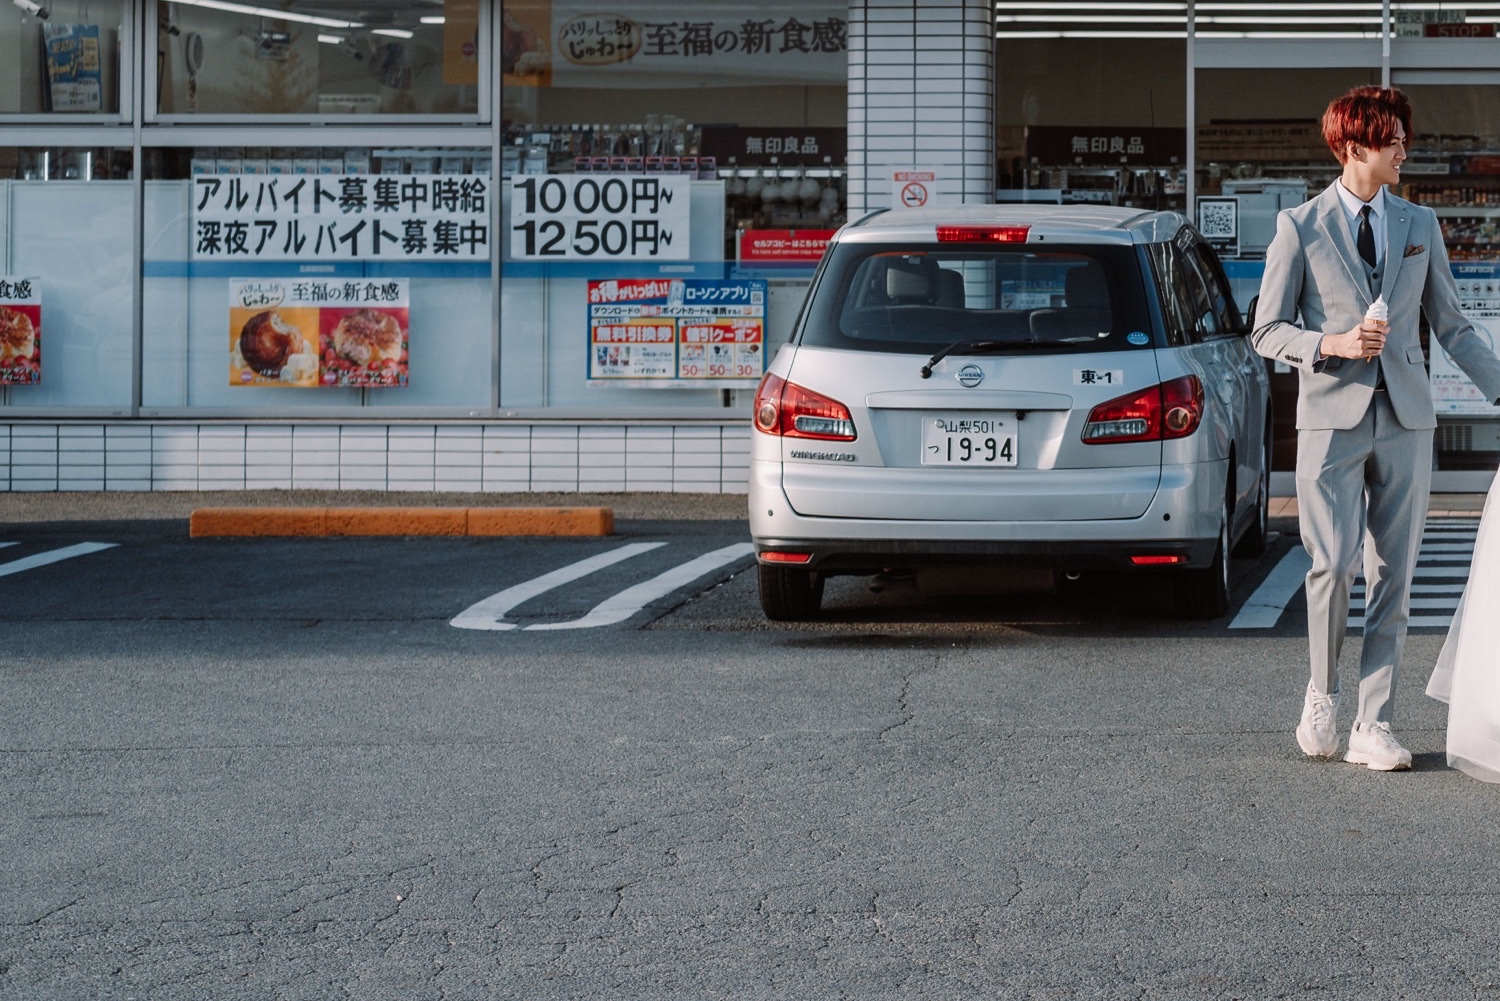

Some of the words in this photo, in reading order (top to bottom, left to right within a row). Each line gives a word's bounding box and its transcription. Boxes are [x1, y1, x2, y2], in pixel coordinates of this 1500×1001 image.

[644, 17, 847, 56] 至福の新食感
[746, 136, 819, 154] 無印良品
[1072, 136, 1144, 154] 無印良品
[196, 177, 487, 214] アルバイト募集中時給
[196, 219, 487, 256] 深夜アルバイト募集中
[291, 282, 400, 302] 至福の新食感
[686, 286, 748, 300] ローソンアプリ
[1081, 370, 1112, 384] 東-1
[945, 420, 994, 434] 山梨501
[928, 445, 940, 454] つ
[947, 437, 1013, 462] 19-94
